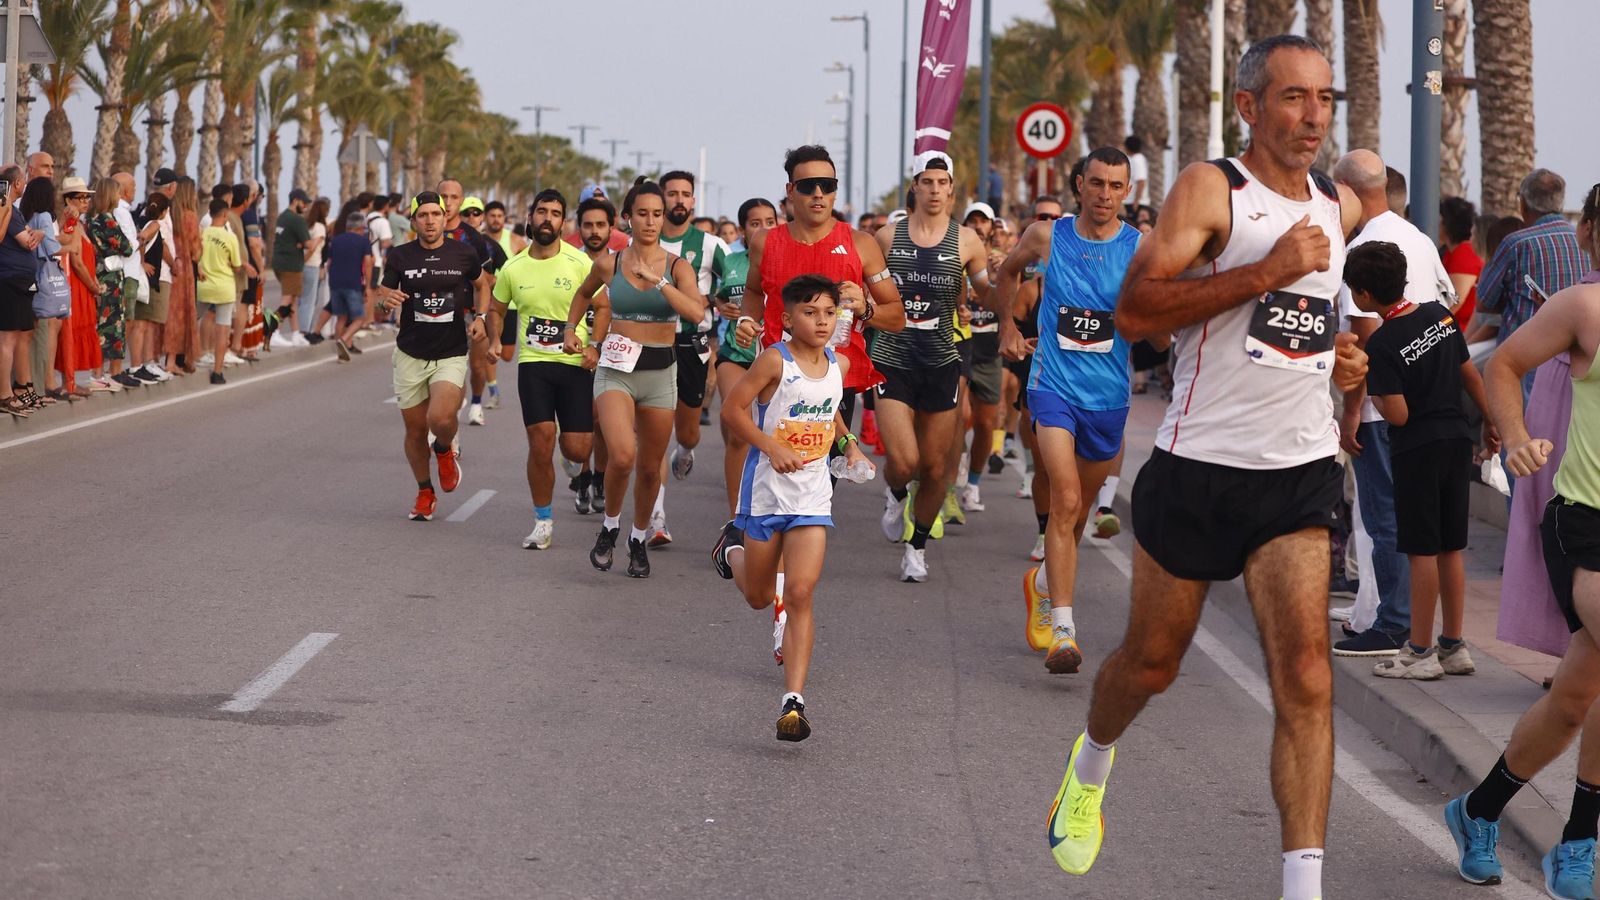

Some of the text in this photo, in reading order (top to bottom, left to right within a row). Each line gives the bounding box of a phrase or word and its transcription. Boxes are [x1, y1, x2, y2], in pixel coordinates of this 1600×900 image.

[1028, 119, 1057, 140] 40
[423, 298, 446, 307] 957
[904, 300, 931, 312] 987
[1072, 316, 1101, 331] 719
[1267, 306, 1326, 335] 2596
[535, 324, 559, 336] 929
[1400, 321, 1446, 358] POLICIA
[606, 341, 633, 354] 3091
[786, 432, 823, 446] 4611
